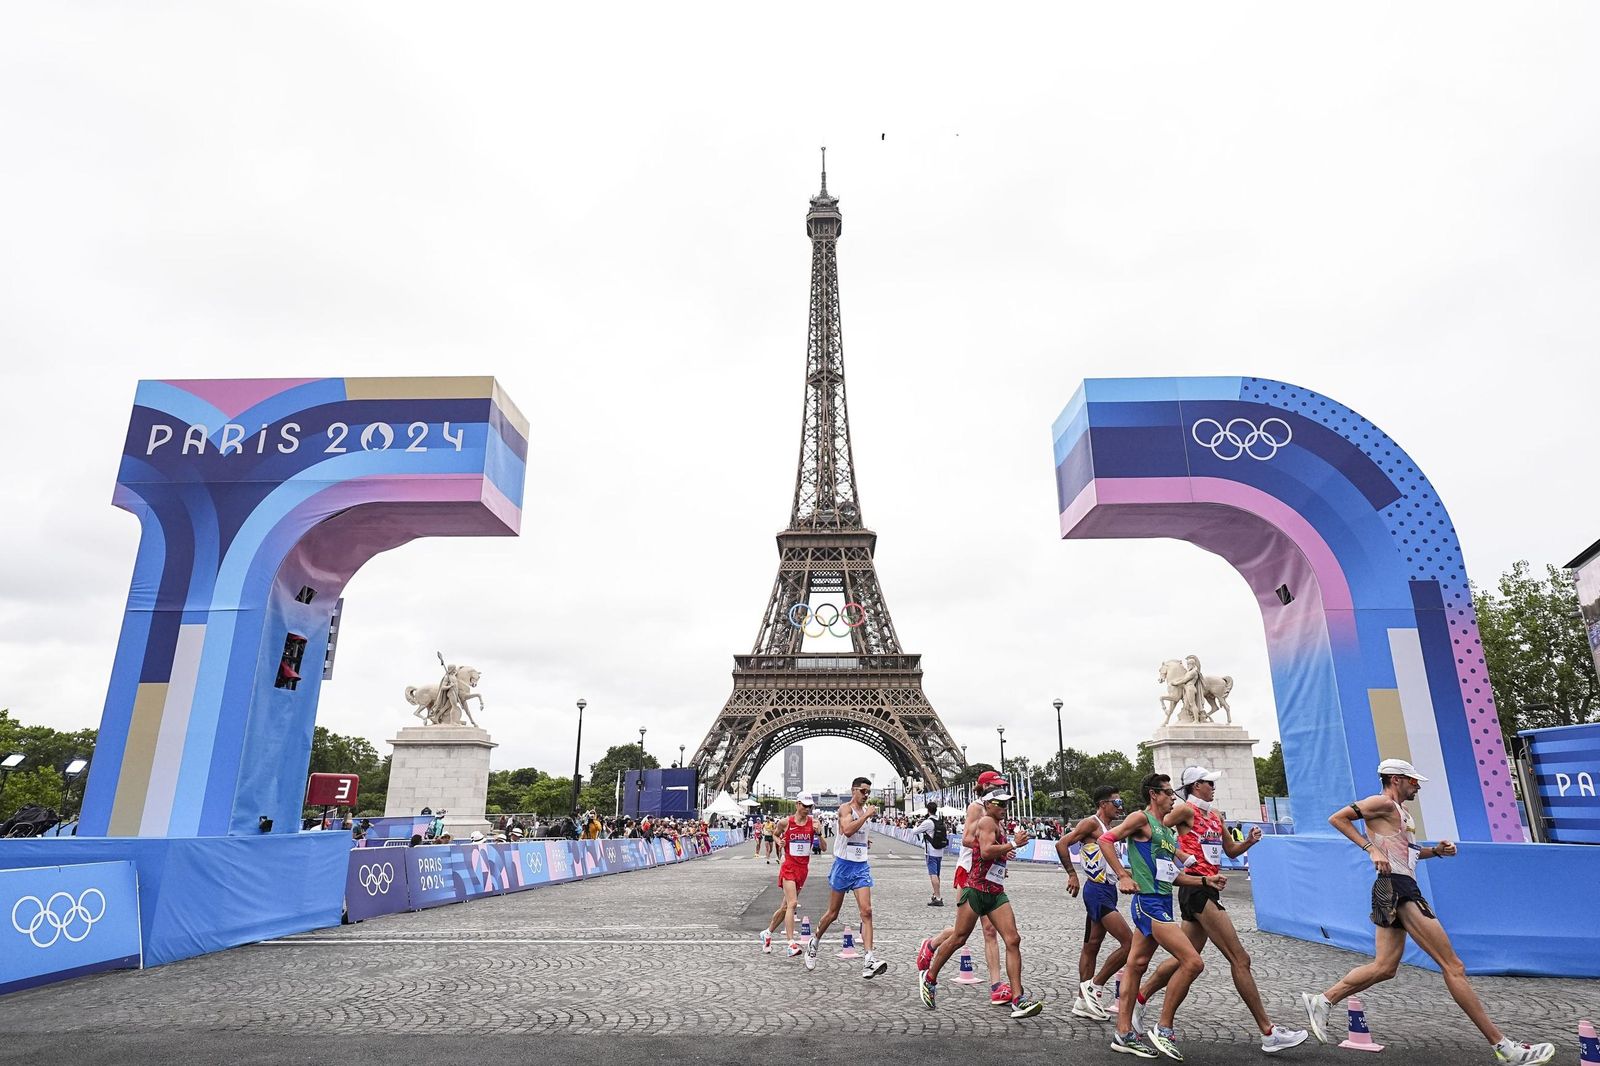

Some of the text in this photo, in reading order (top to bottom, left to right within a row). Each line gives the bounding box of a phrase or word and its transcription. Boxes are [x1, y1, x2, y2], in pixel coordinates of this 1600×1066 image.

[323, 421, 464, 453] 2024
[334, 779, 352, 799] 3
[420, 874, 445, 891] 2024
